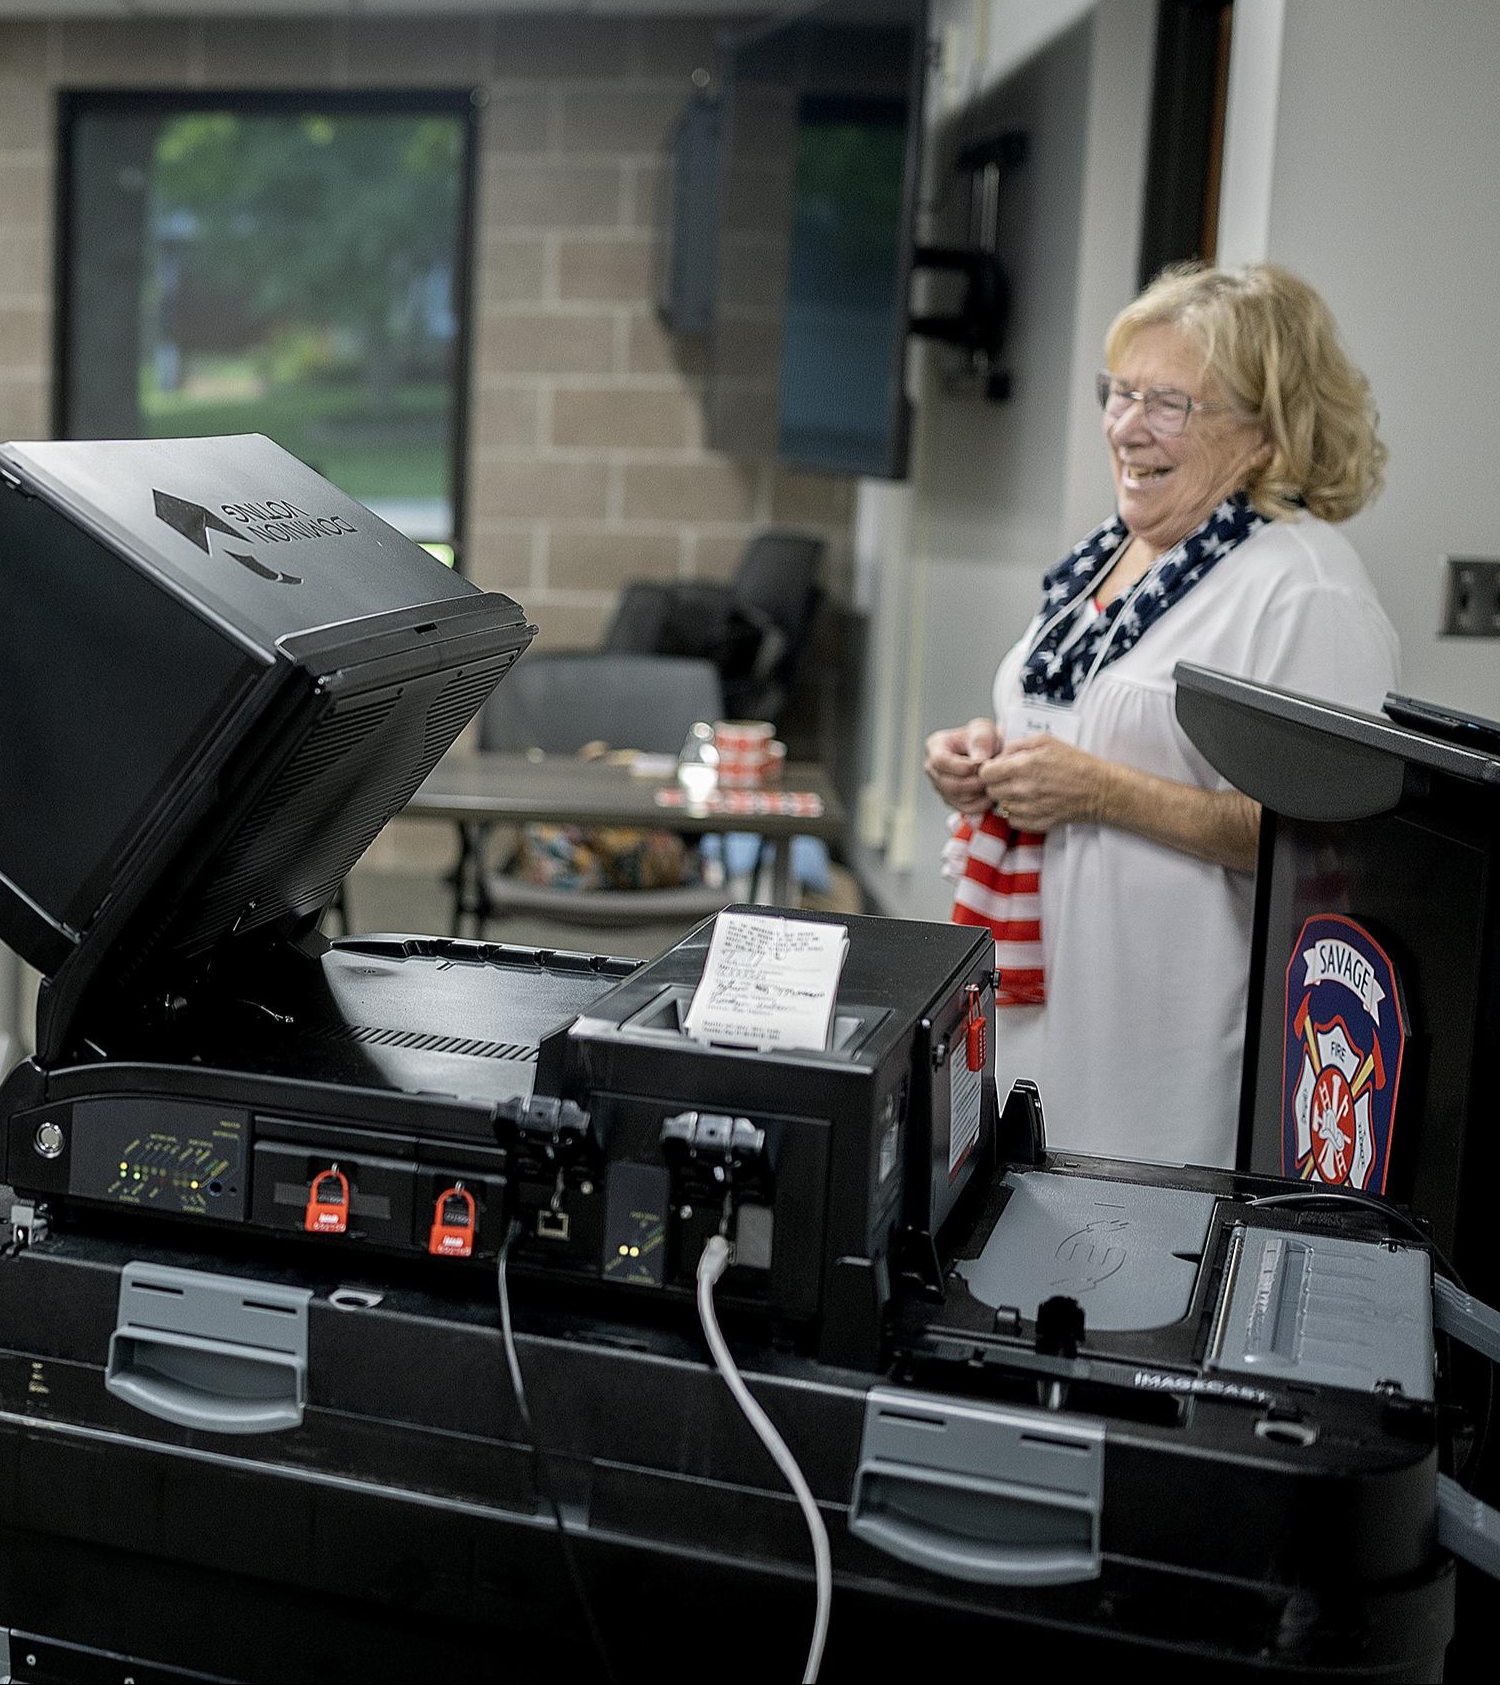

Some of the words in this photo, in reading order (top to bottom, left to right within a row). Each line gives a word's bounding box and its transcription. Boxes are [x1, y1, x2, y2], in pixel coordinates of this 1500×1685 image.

[220, 499, 310, 523] VOTING
[246, 515, 358, 543] DOMINION
[1320, 944, 1371, 998] SAVAGE
[1330, 1041, 1347, 1063] FIRE
